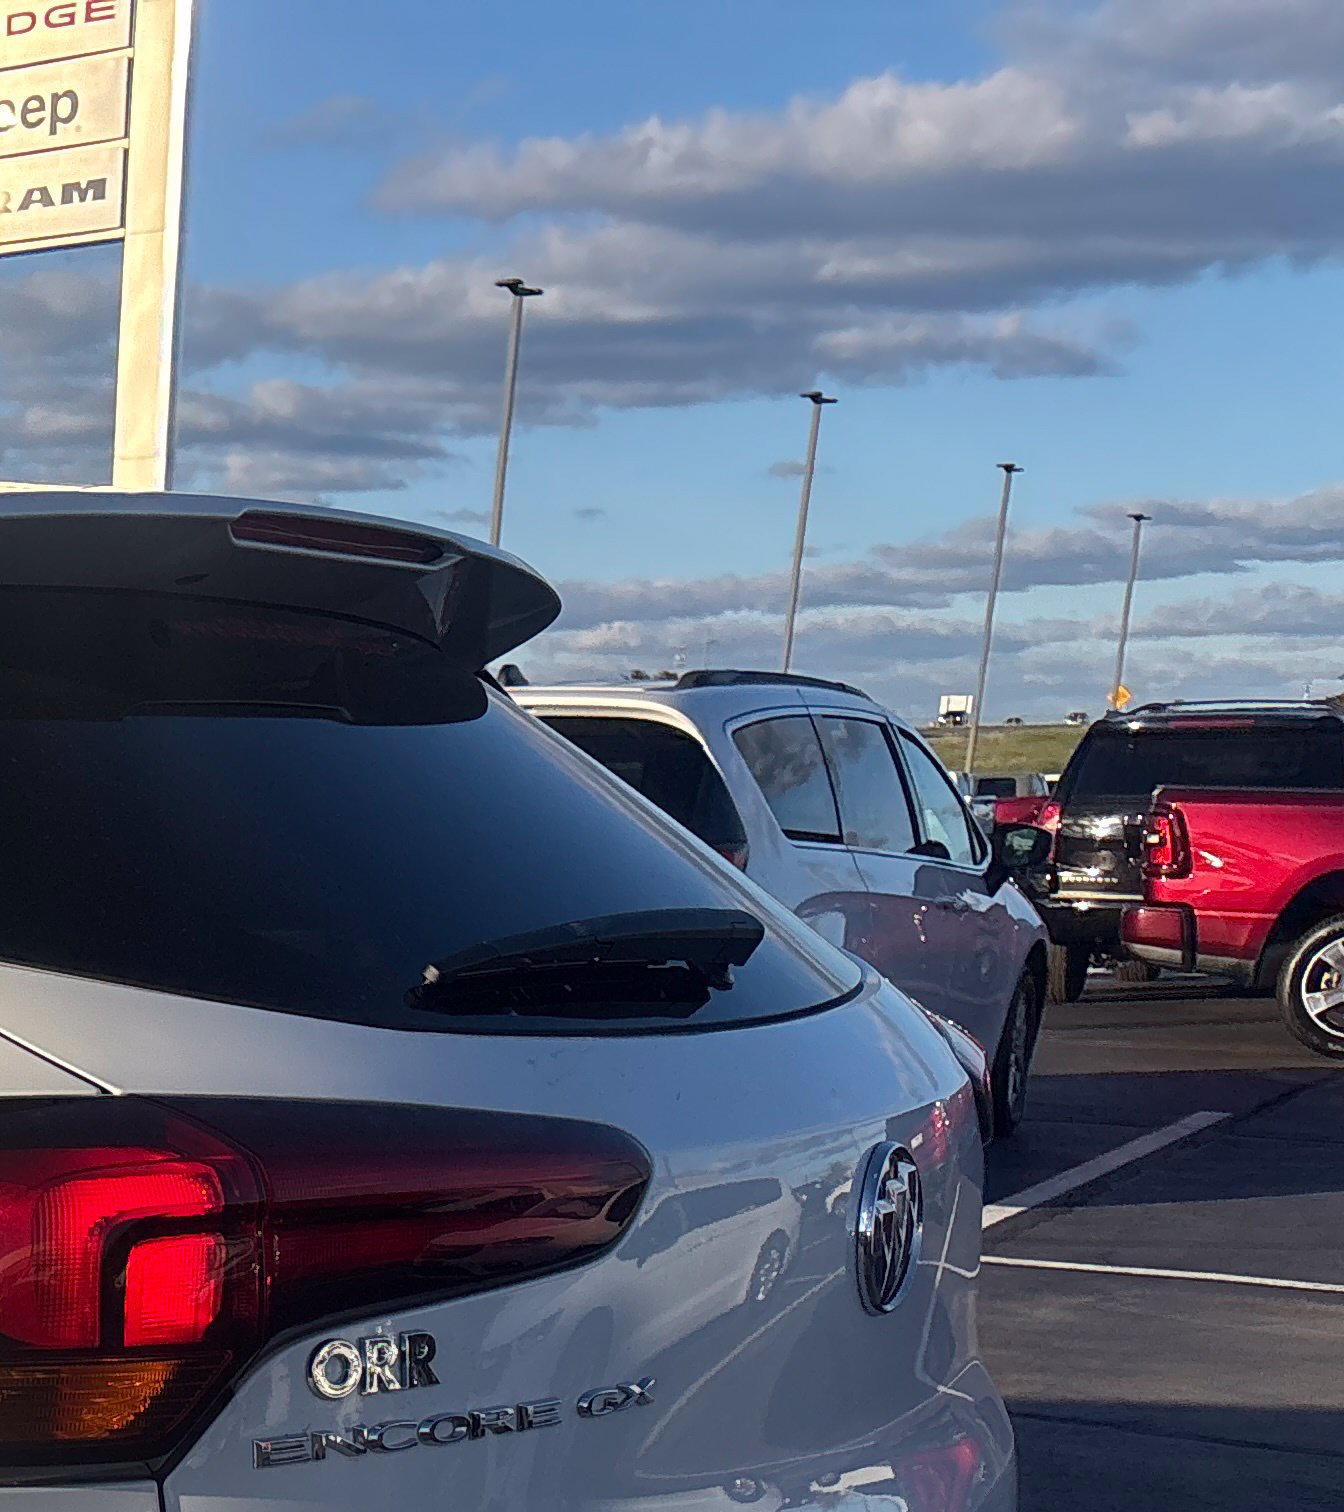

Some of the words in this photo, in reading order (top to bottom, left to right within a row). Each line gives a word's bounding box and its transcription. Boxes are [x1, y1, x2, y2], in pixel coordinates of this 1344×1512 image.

[305, 1329, 441, 1401] ORR
[252, 1396, 563, 1470] ENCORE
[575, 1375, 657, 1419] GX
